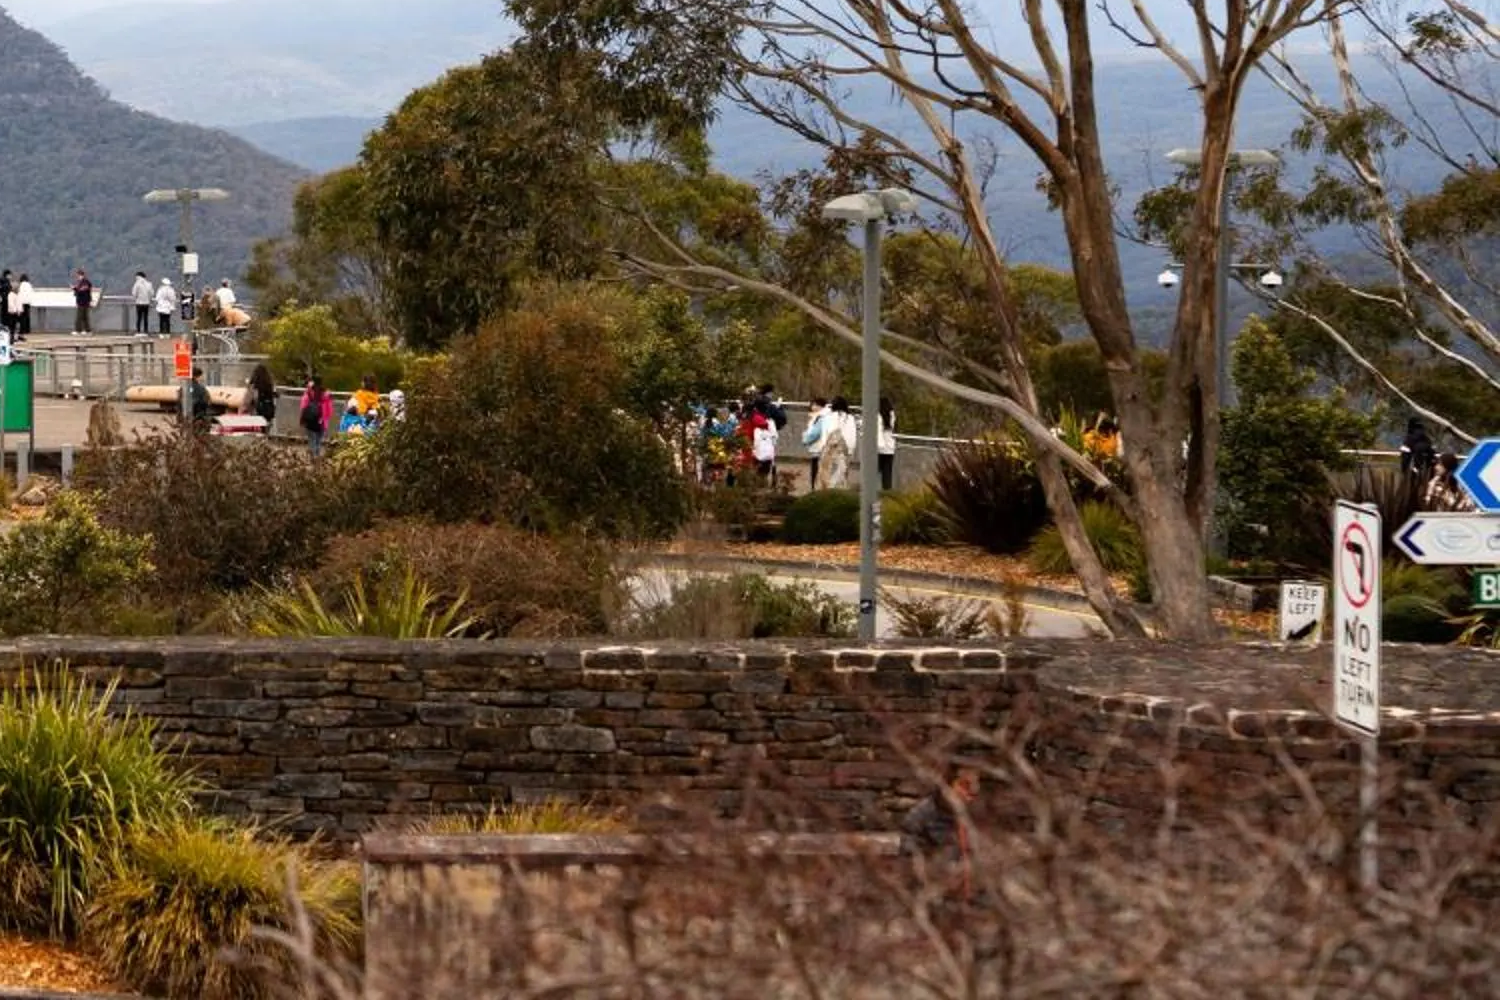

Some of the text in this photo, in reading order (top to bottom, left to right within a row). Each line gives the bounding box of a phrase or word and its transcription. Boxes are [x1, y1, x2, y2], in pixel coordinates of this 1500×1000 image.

[1289, 587, 1318, 600] KEEP
[1481, 573, 1500, 602] B
[1289, 602, 1317, 616] LEFT
[1343, 615, 1371, 653] NO
[1341, 654, 1372, 682] LEFT
[1340, 678, 1375, 708] TURN
